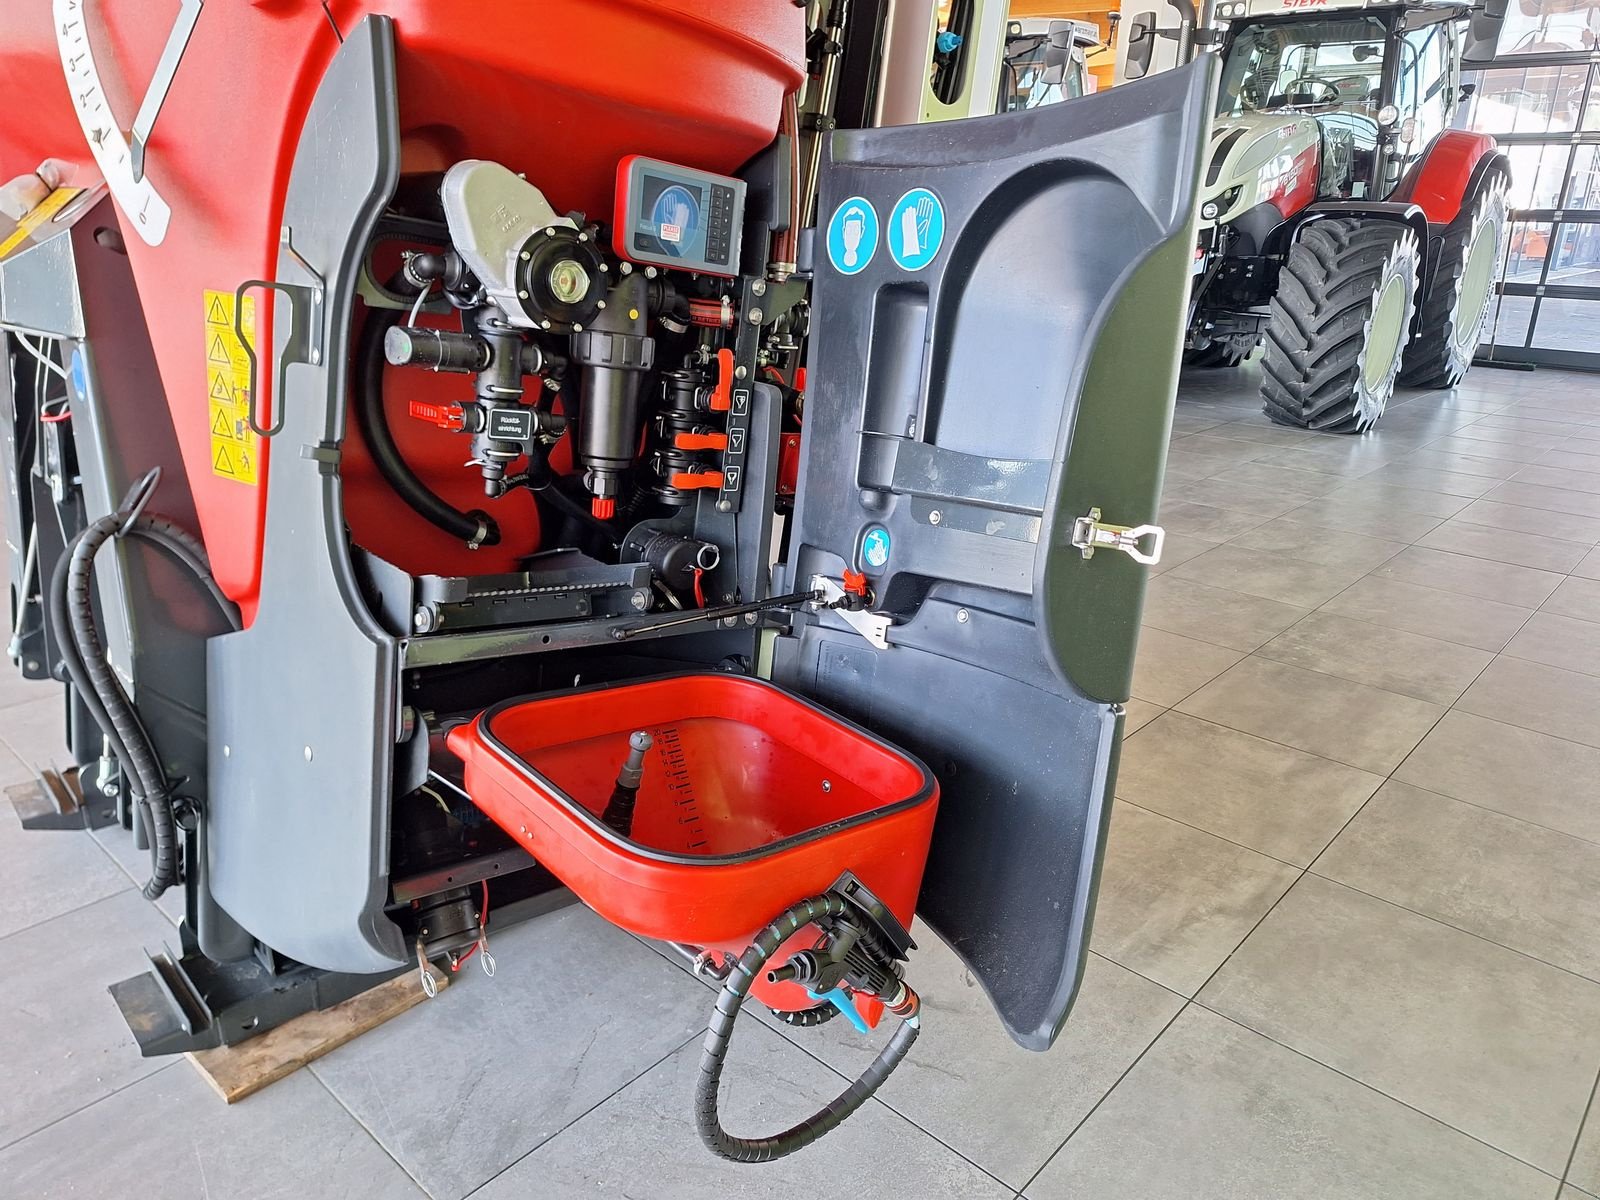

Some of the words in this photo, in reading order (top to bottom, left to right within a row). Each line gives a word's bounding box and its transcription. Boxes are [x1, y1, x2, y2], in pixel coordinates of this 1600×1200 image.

[62, 23, 69, 36] 4
[69, 58, 76, 72] 3
[80, 93, 87, 108] 2
[138, 212, 147, 225] 0
